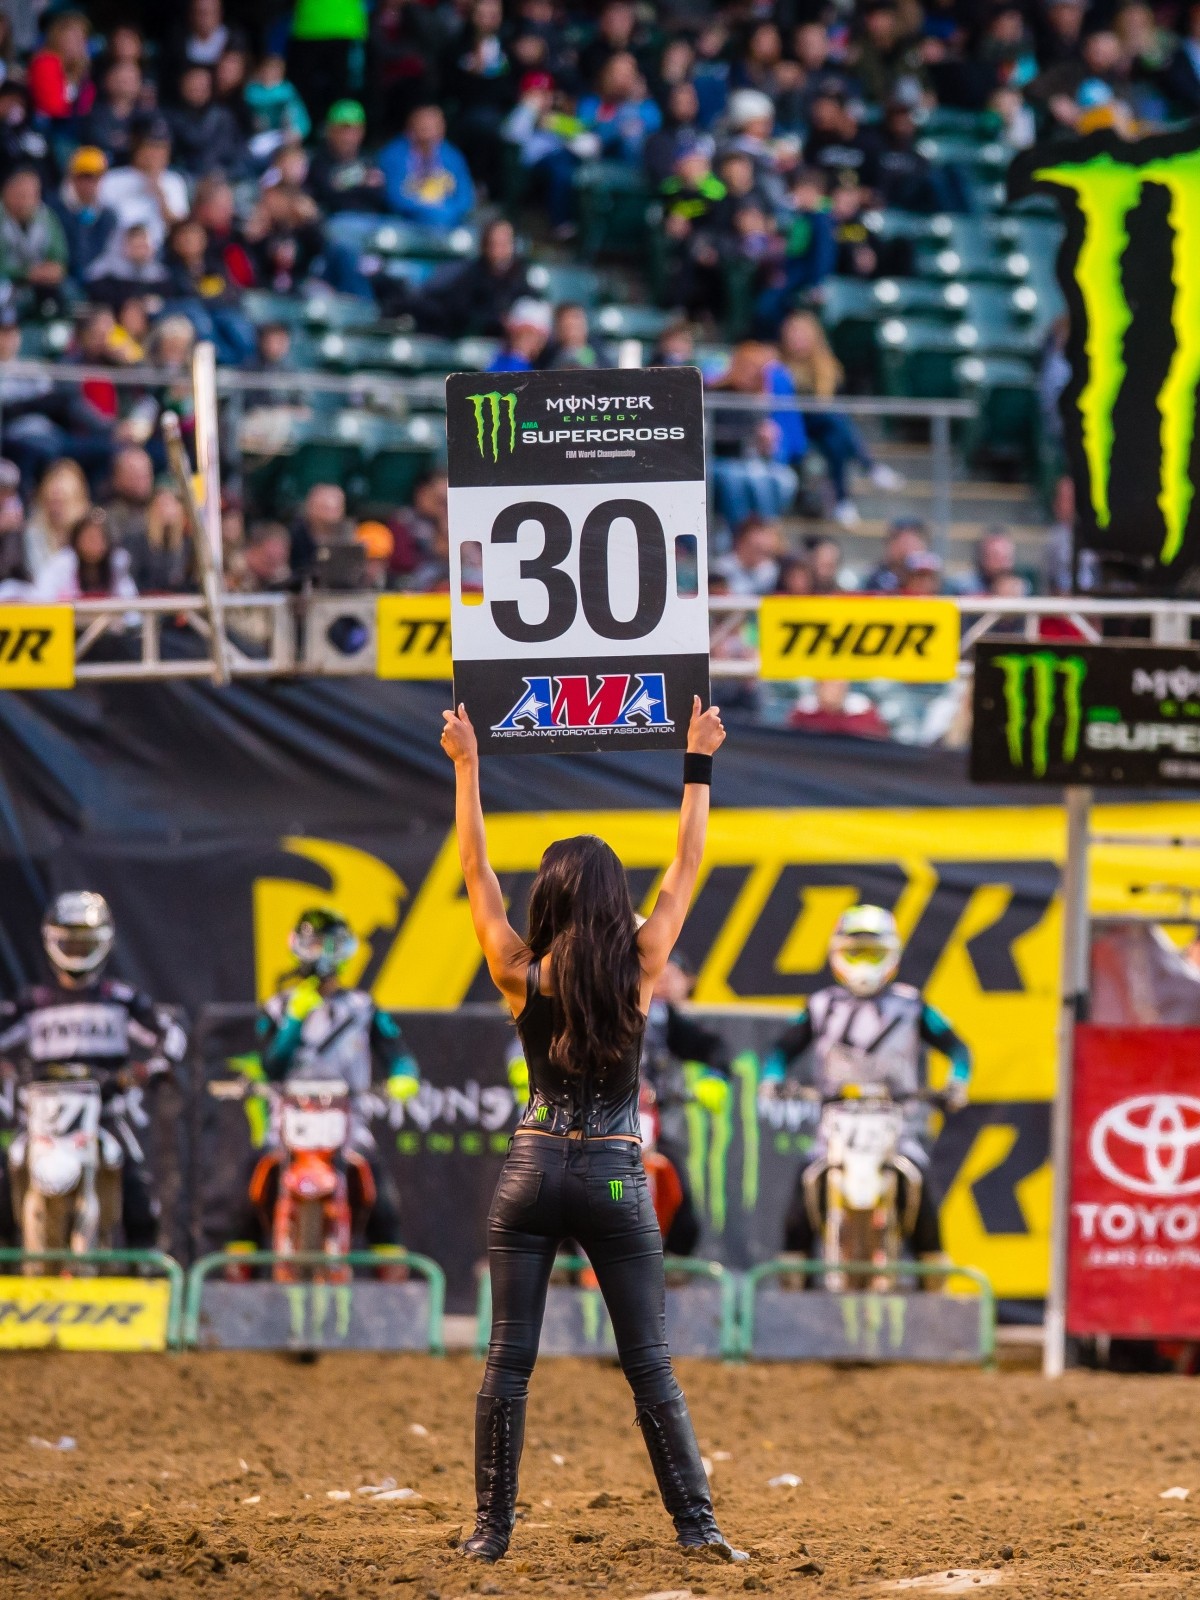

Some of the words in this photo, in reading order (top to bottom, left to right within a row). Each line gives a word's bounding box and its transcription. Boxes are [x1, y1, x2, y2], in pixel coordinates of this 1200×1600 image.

[546, 395, 654, 413] MONSTER
[521, 421, 539, 429] AMA
[563, 414, 638, 422] ENERGY
[522, 427, 685, 444] SUPERCROSS
[565, 450, 577, 459] FIM
[577, 450, 596, 458] World
[597, 449, 636, 459] Championship
[490, 498, 668, 643] 30
[779, 620, 937, 657] THOR
[490, 672, 676, 730] AMA
[491, 730, 540, 738] AMERICAN
[541, 728, 612, 737] MOTORCYCLIST
[614, 726, 676, 735] ASSOCIATION
[0, 1302, 144, 1325] HOR
